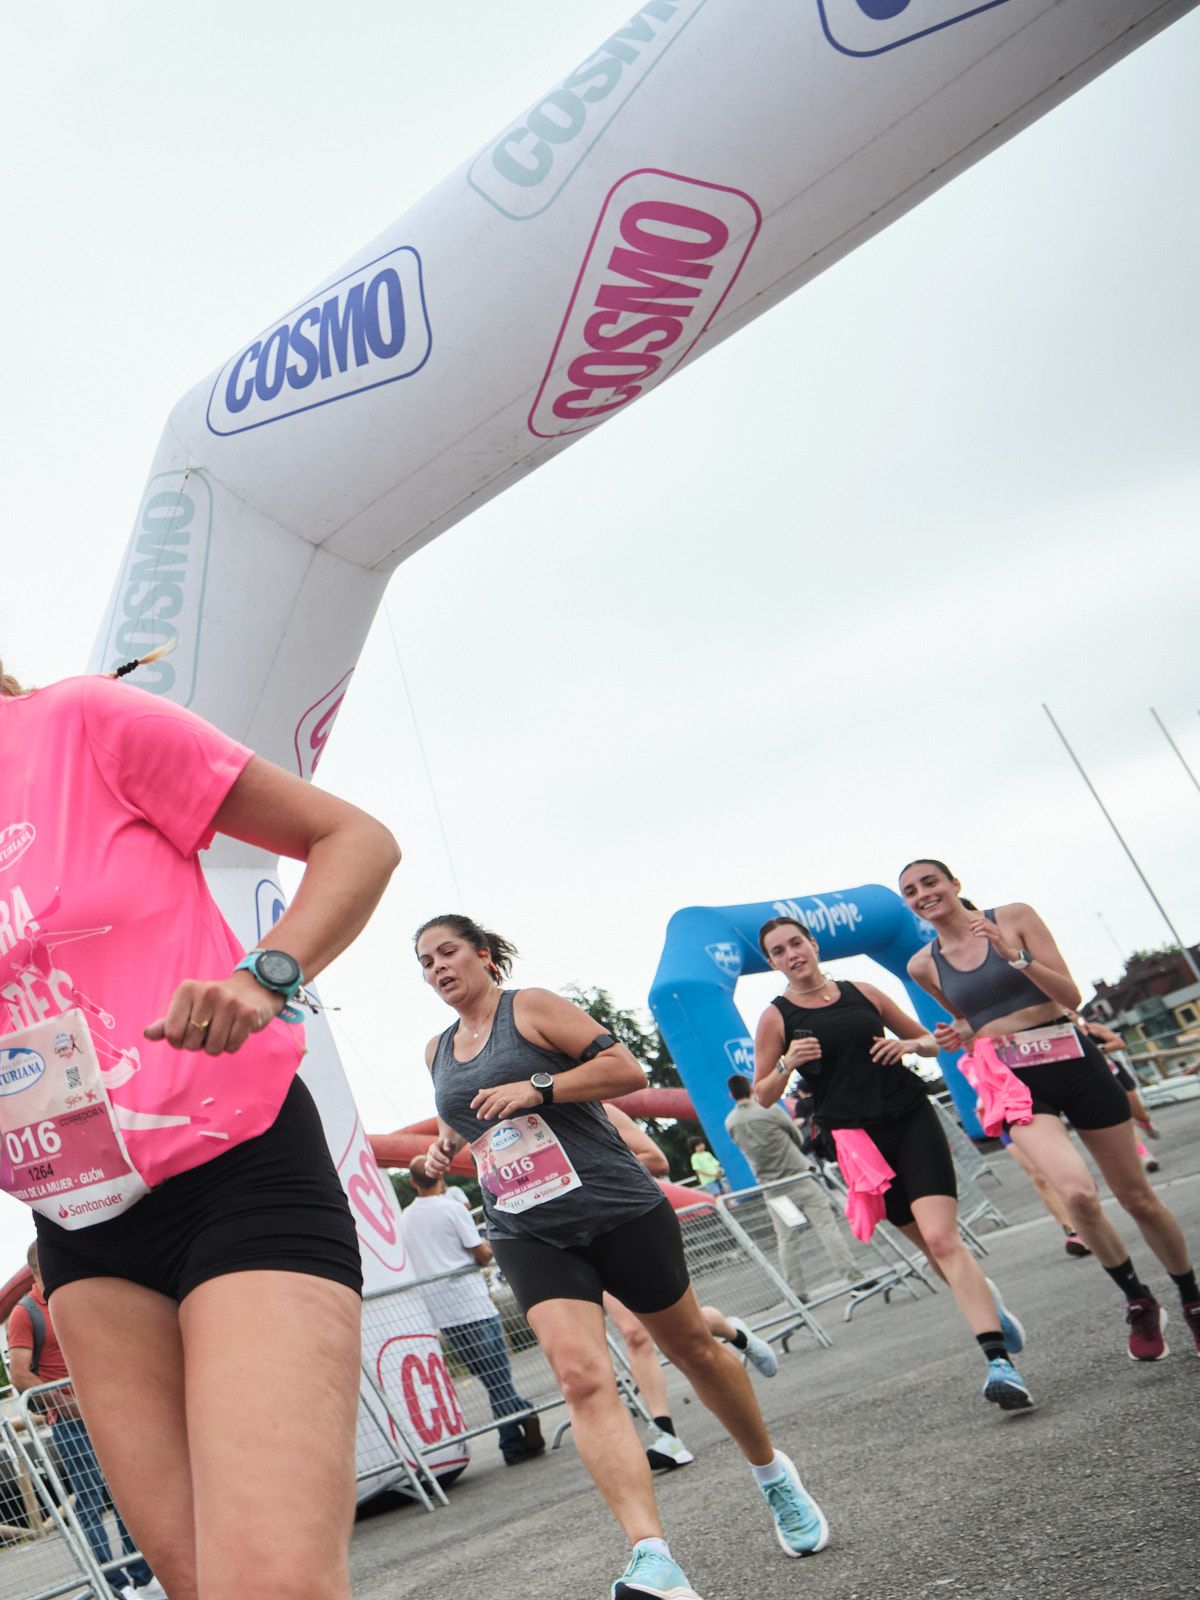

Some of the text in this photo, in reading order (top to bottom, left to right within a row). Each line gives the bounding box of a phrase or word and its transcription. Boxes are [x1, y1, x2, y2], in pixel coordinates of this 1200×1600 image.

[492, 0, 683, 188] COSM
[552, 200, 729, 420] COSMO
[225, 267, 406, 413] COSMO
[1020, 1040, 1052, 1055] 016
[6, 1121, 62, 1164] 016
[28, 1162, 55, 1182] 1264
[46, 1177, 74, 1193] MUJER
[79, 1167, 105, 1184] GIJÓN
[500, 1156, 535, 1181] 016
[69, 1193, 122, 1217] Santander
